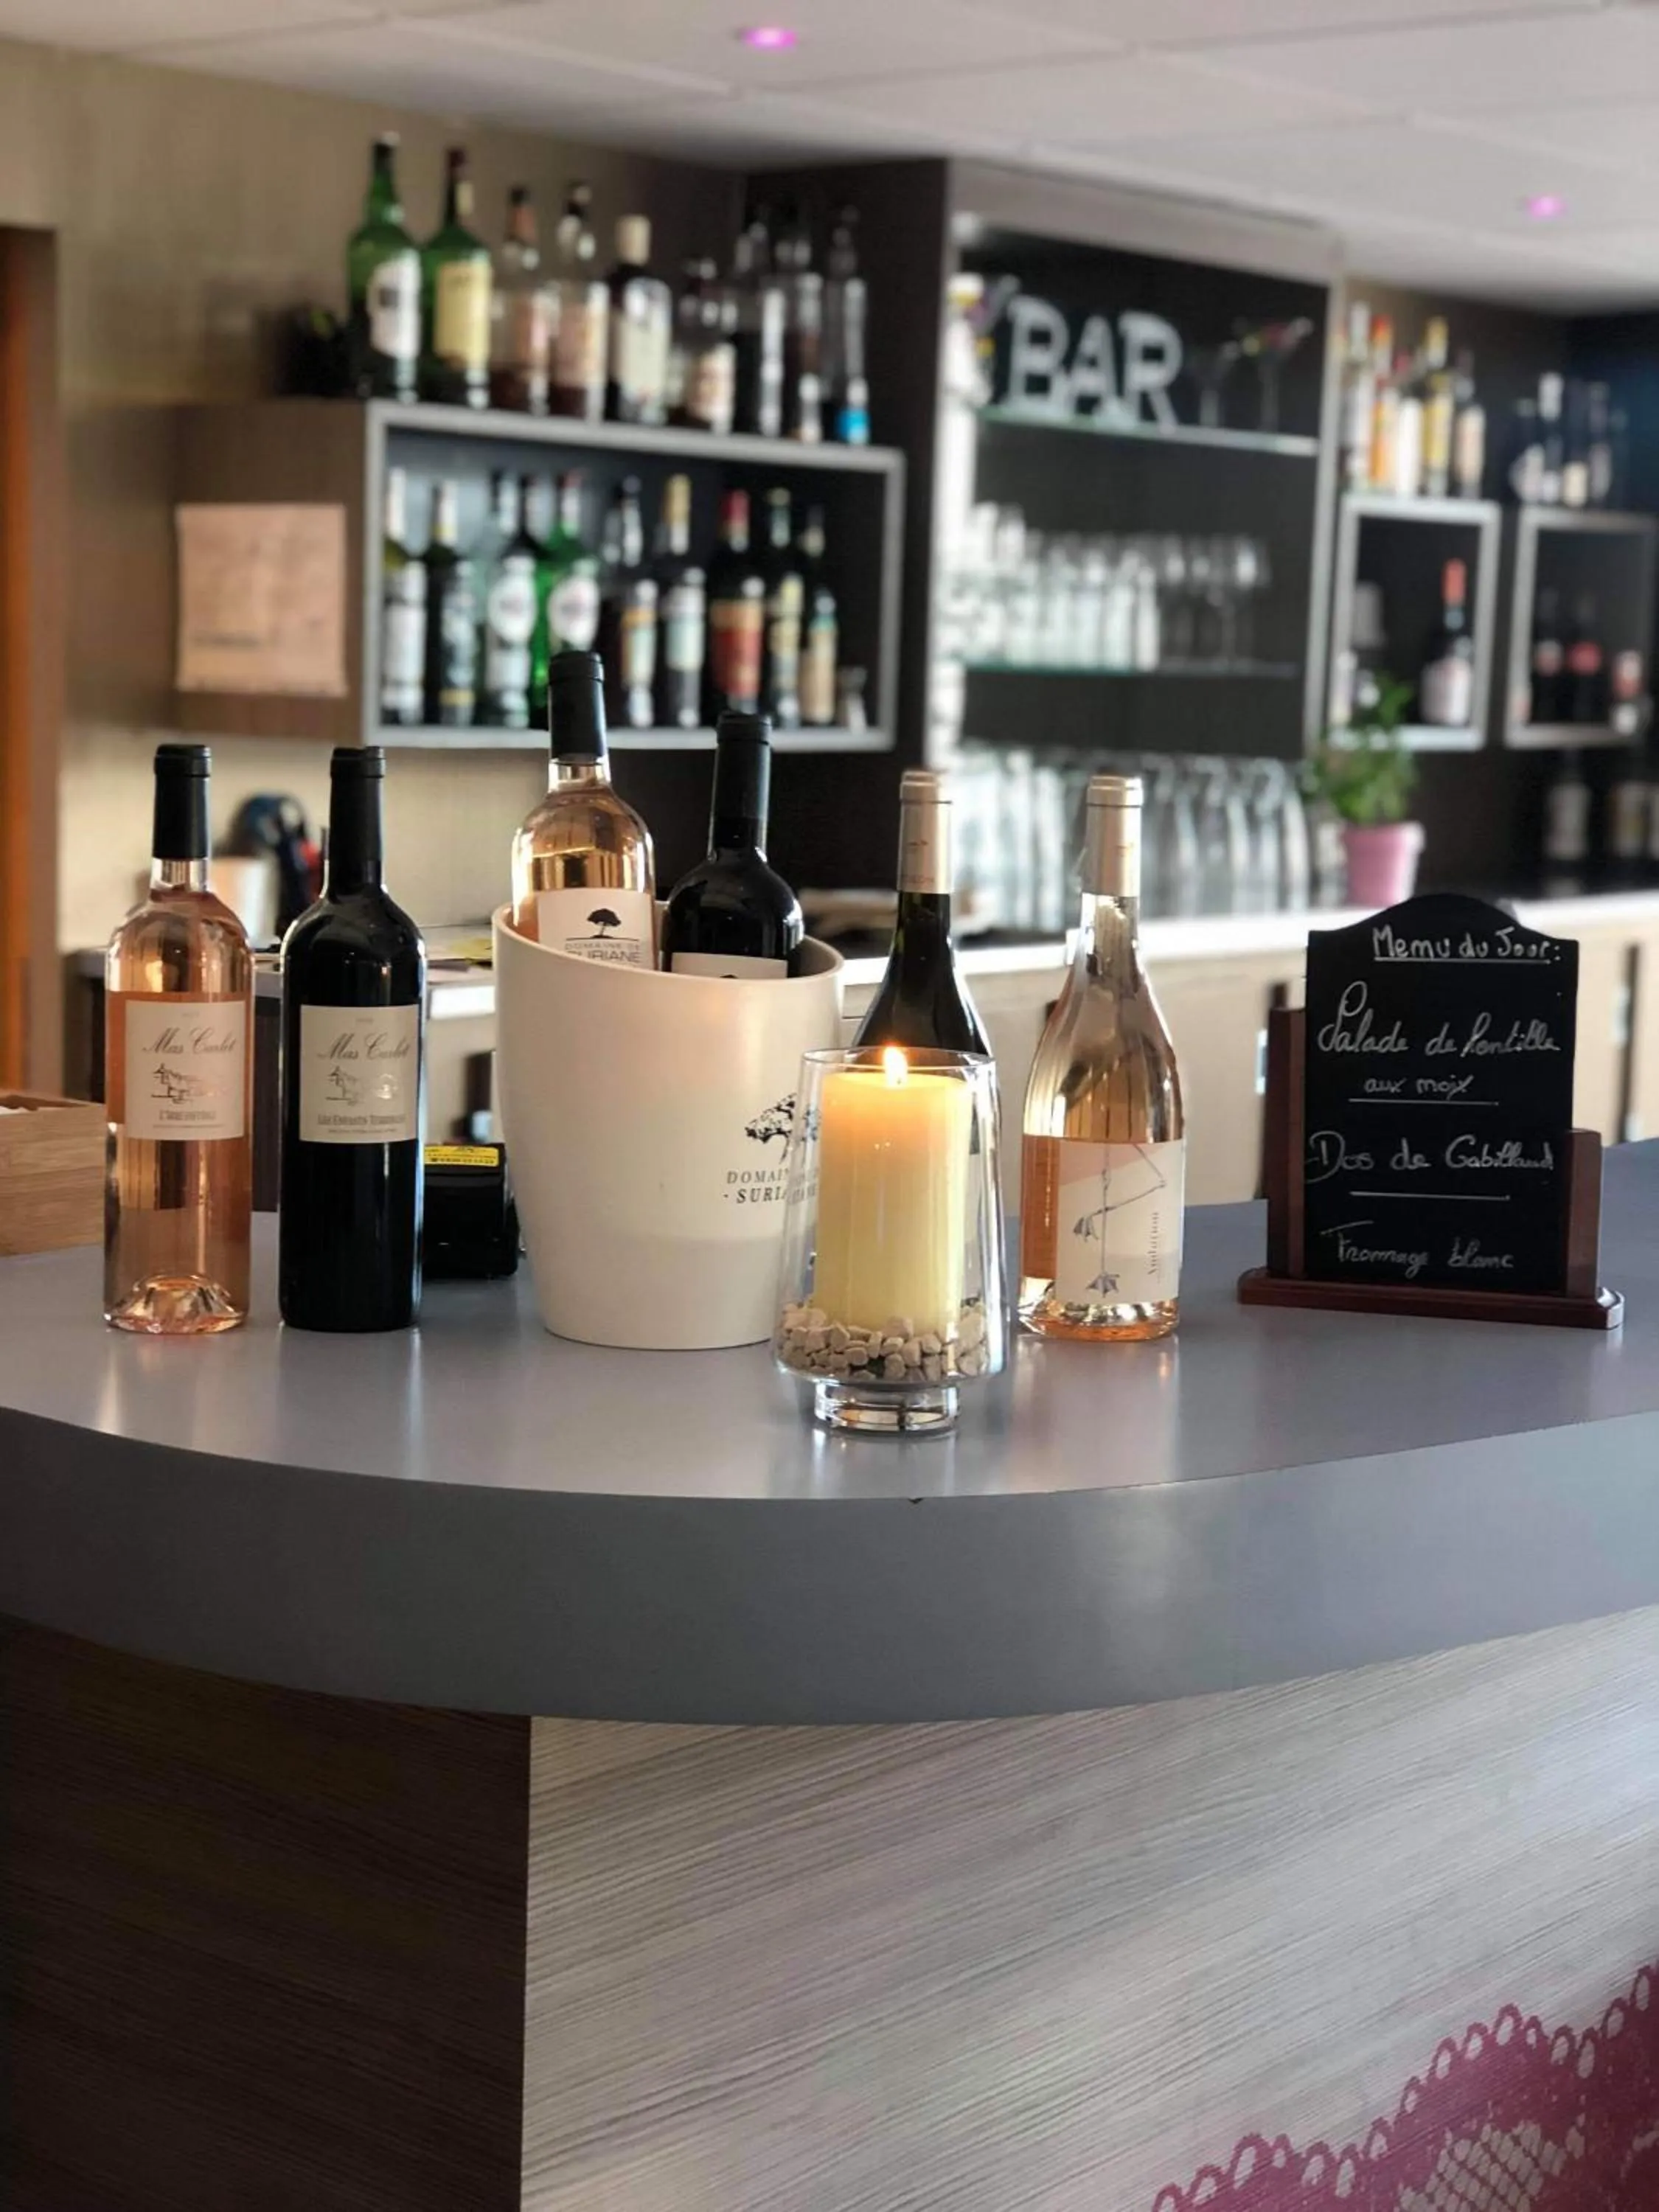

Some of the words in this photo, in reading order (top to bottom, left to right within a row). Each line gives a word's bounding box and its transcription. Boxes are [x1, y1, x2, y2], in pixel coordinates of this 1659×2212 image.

[1007, 295, 1183, 435] BAR
[1458, 932, 1488, 958] du
[1318, 981, 1409, 1053] Salade
[1425, 1022, 1458, 1056] de
[1364, 1077, 1407, 1093] aux
[1305, 1130, 1374, 1183] Dos
[1390, 1137, 1432, 1170] de
